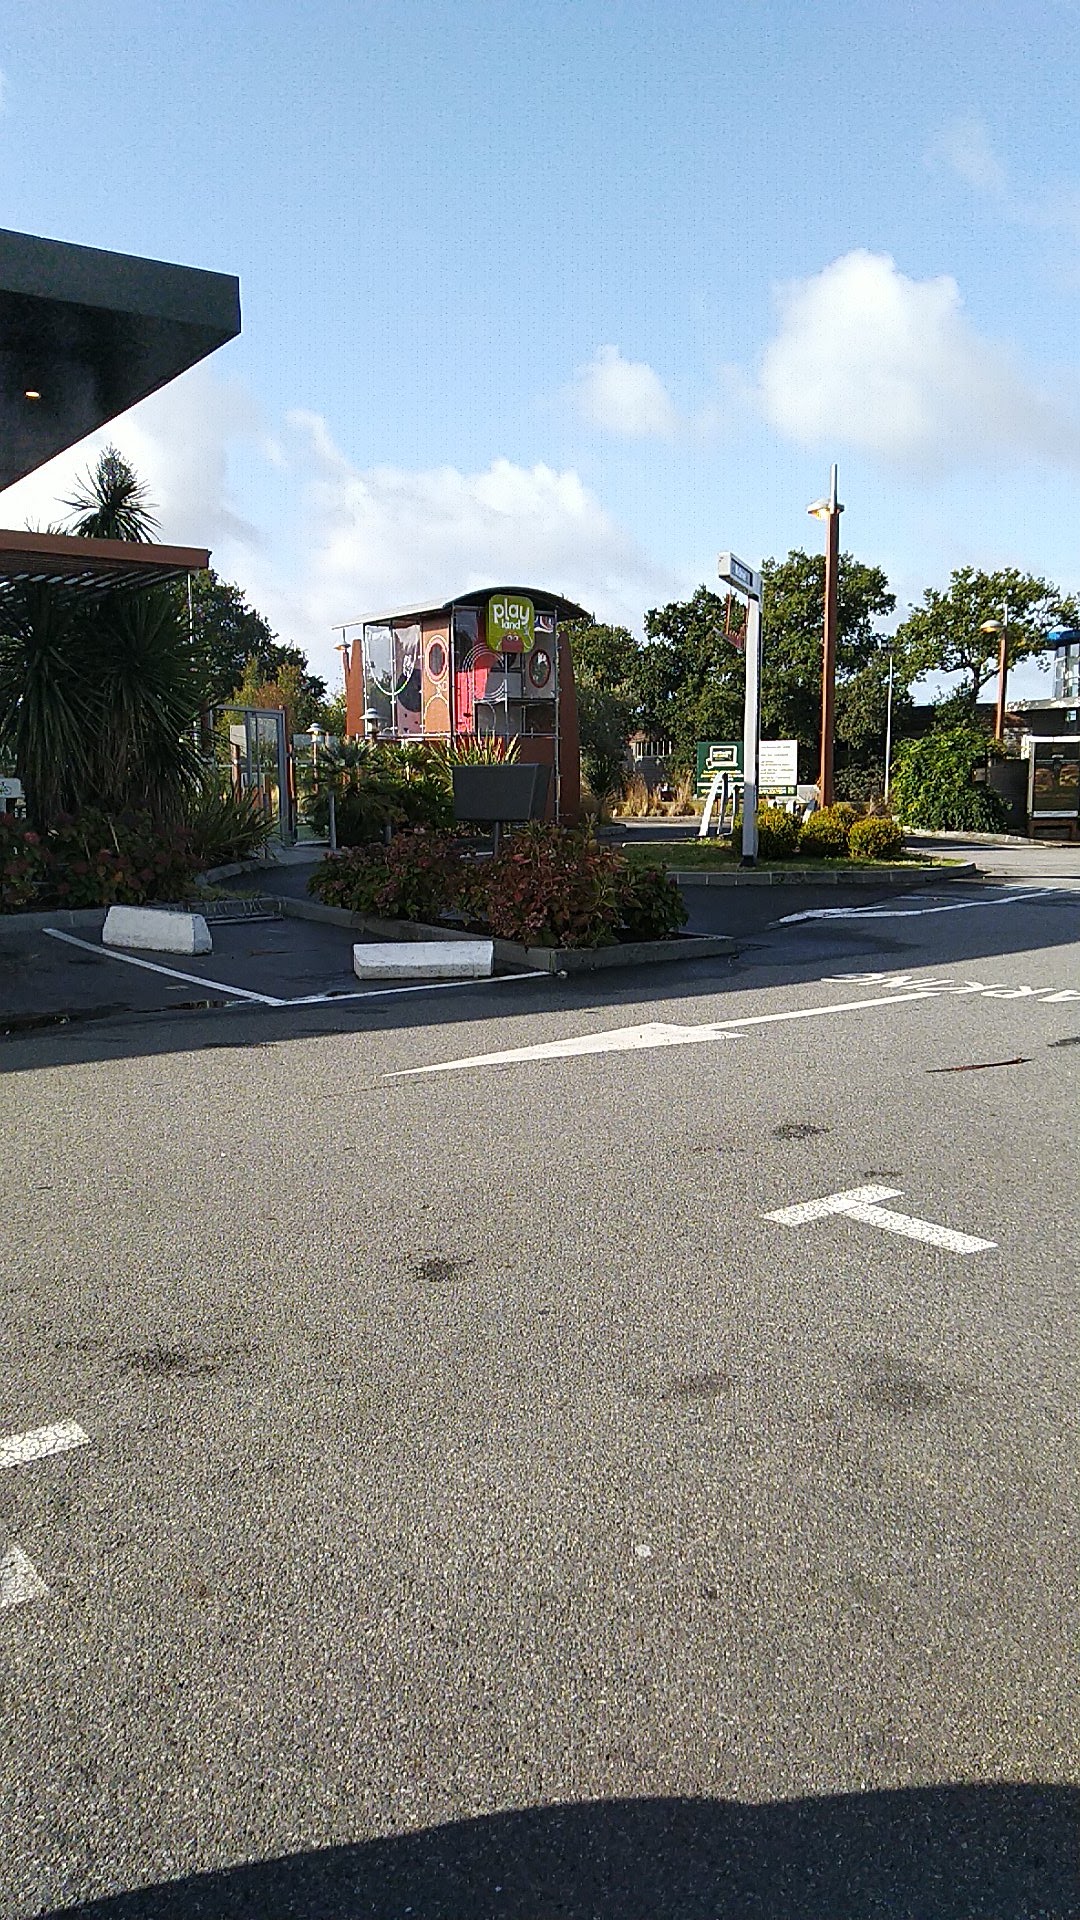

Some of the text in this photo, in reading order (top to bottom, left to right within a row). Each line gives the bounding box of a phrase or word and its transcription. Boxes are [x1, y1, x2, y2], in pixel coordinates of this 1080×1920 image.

[493, 598, 530, 625] play
[501, 618, 520, 629] land
[821, 973, 1080, 1002] ARKING
